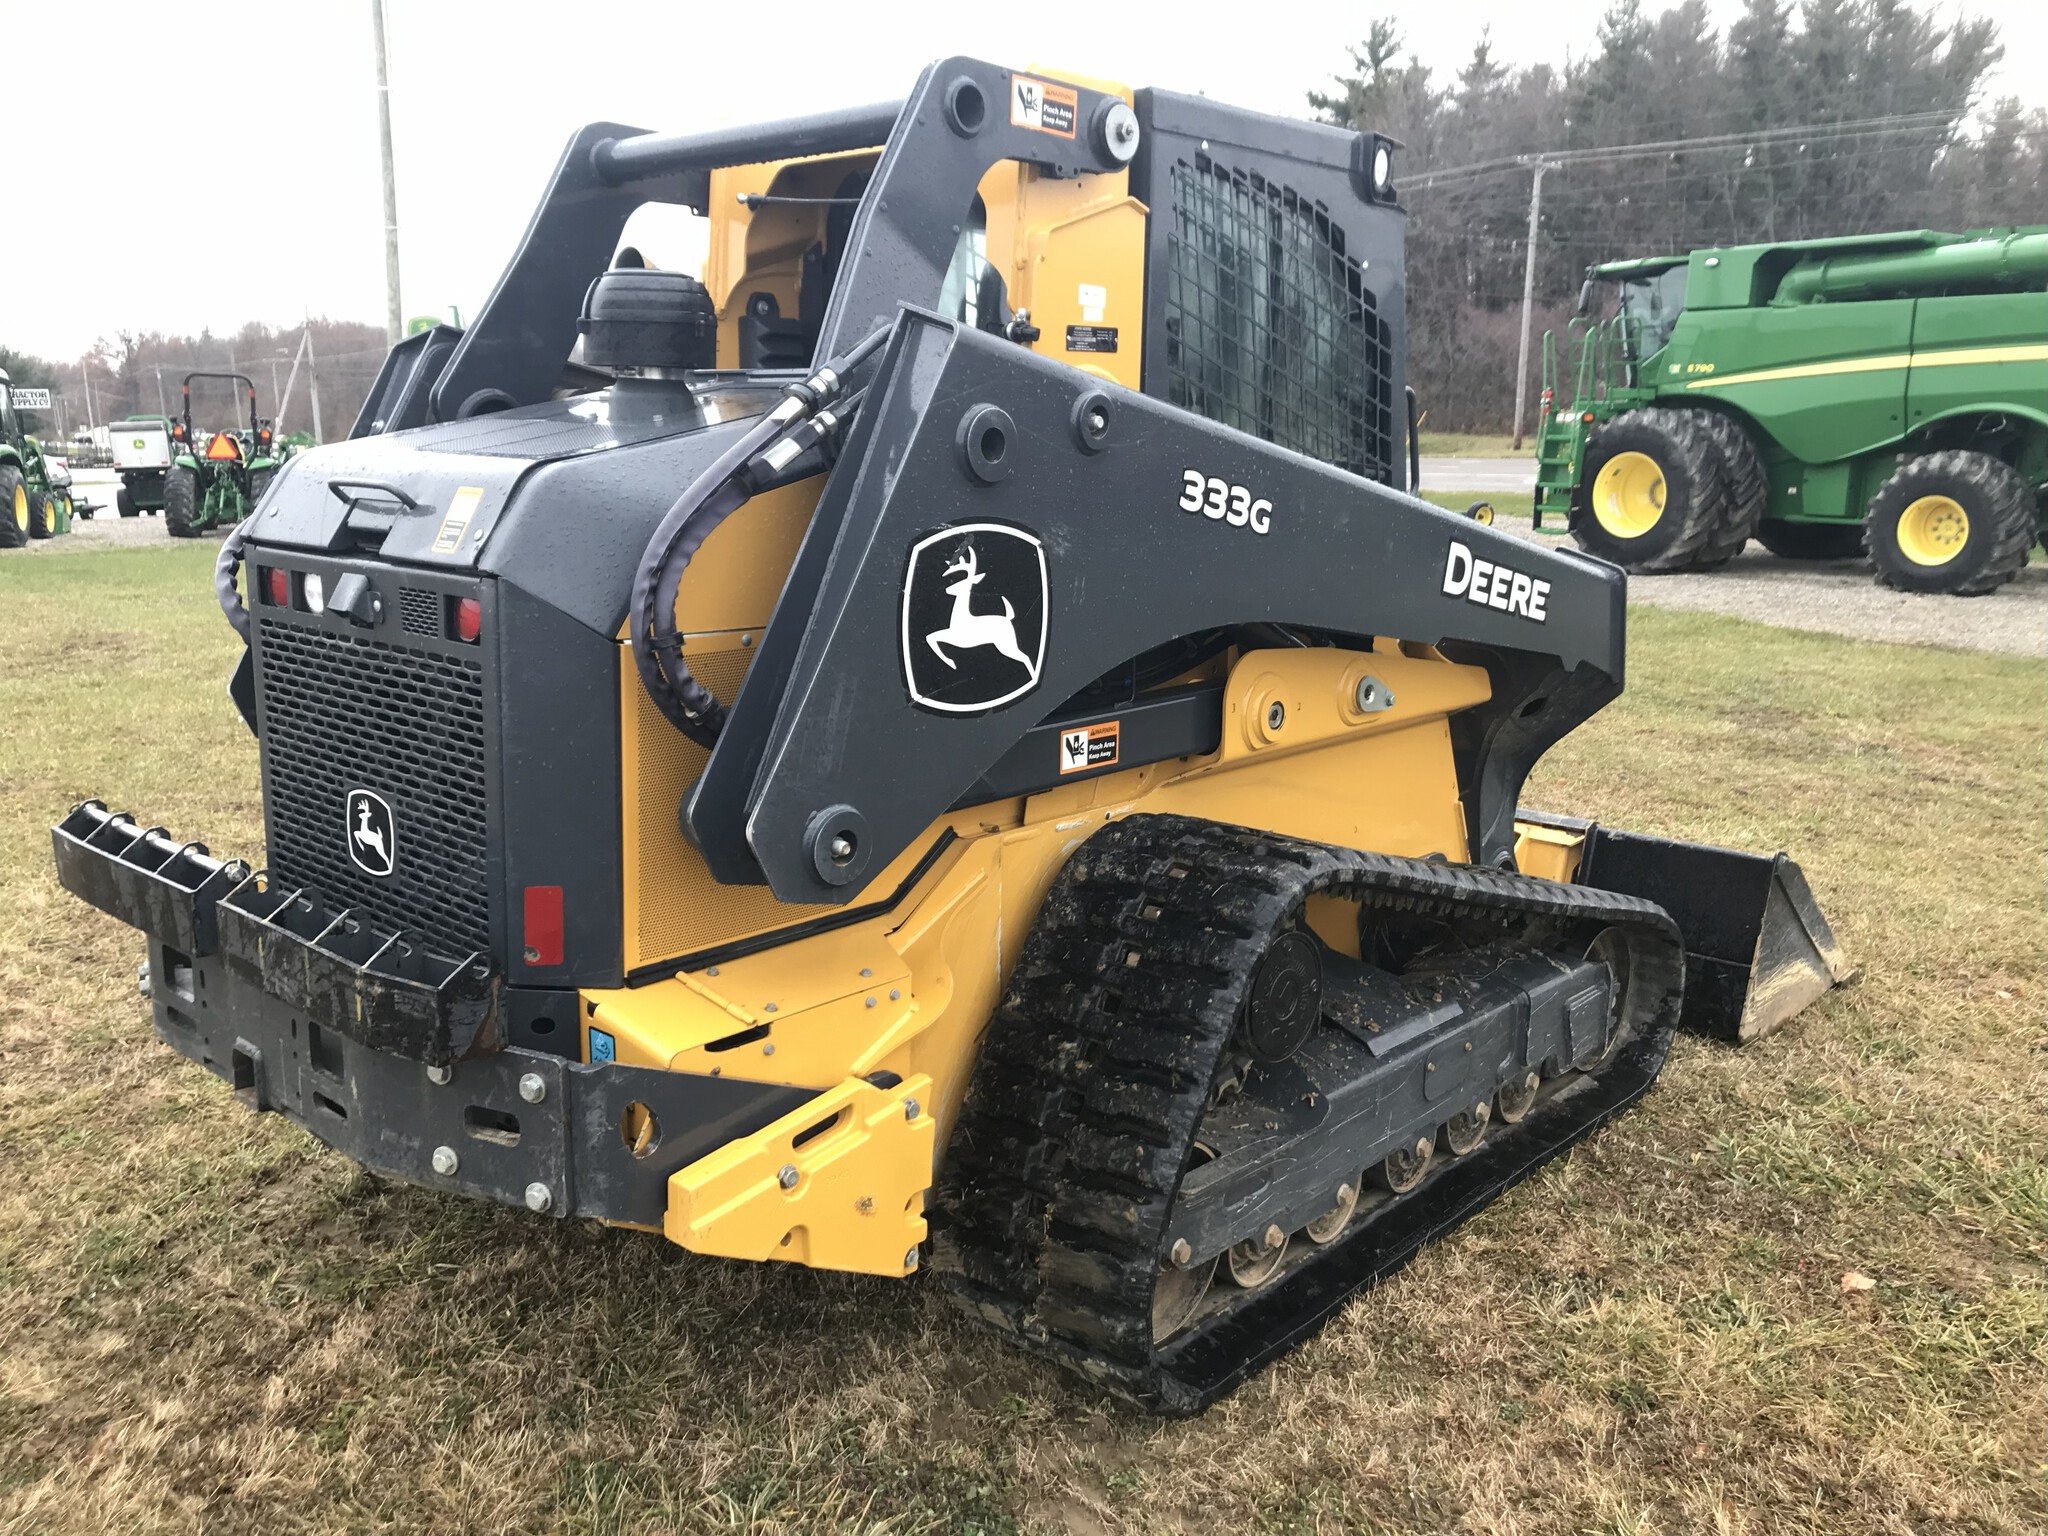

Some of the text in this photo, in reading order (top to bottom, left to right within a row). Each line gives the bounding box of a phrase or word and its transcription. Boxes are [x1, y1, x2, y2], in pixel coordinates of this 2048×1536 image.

[1060, 108, 1072, 119] Area
[1179, 470, 1273, 534] 333G
[1443, 541, 1551, 622] DEERE
[1095, 726, 1116, 735] WARNING
[1089, 743, 1103, 751] Pinch
[1100, 750, 1112, 758] Away
